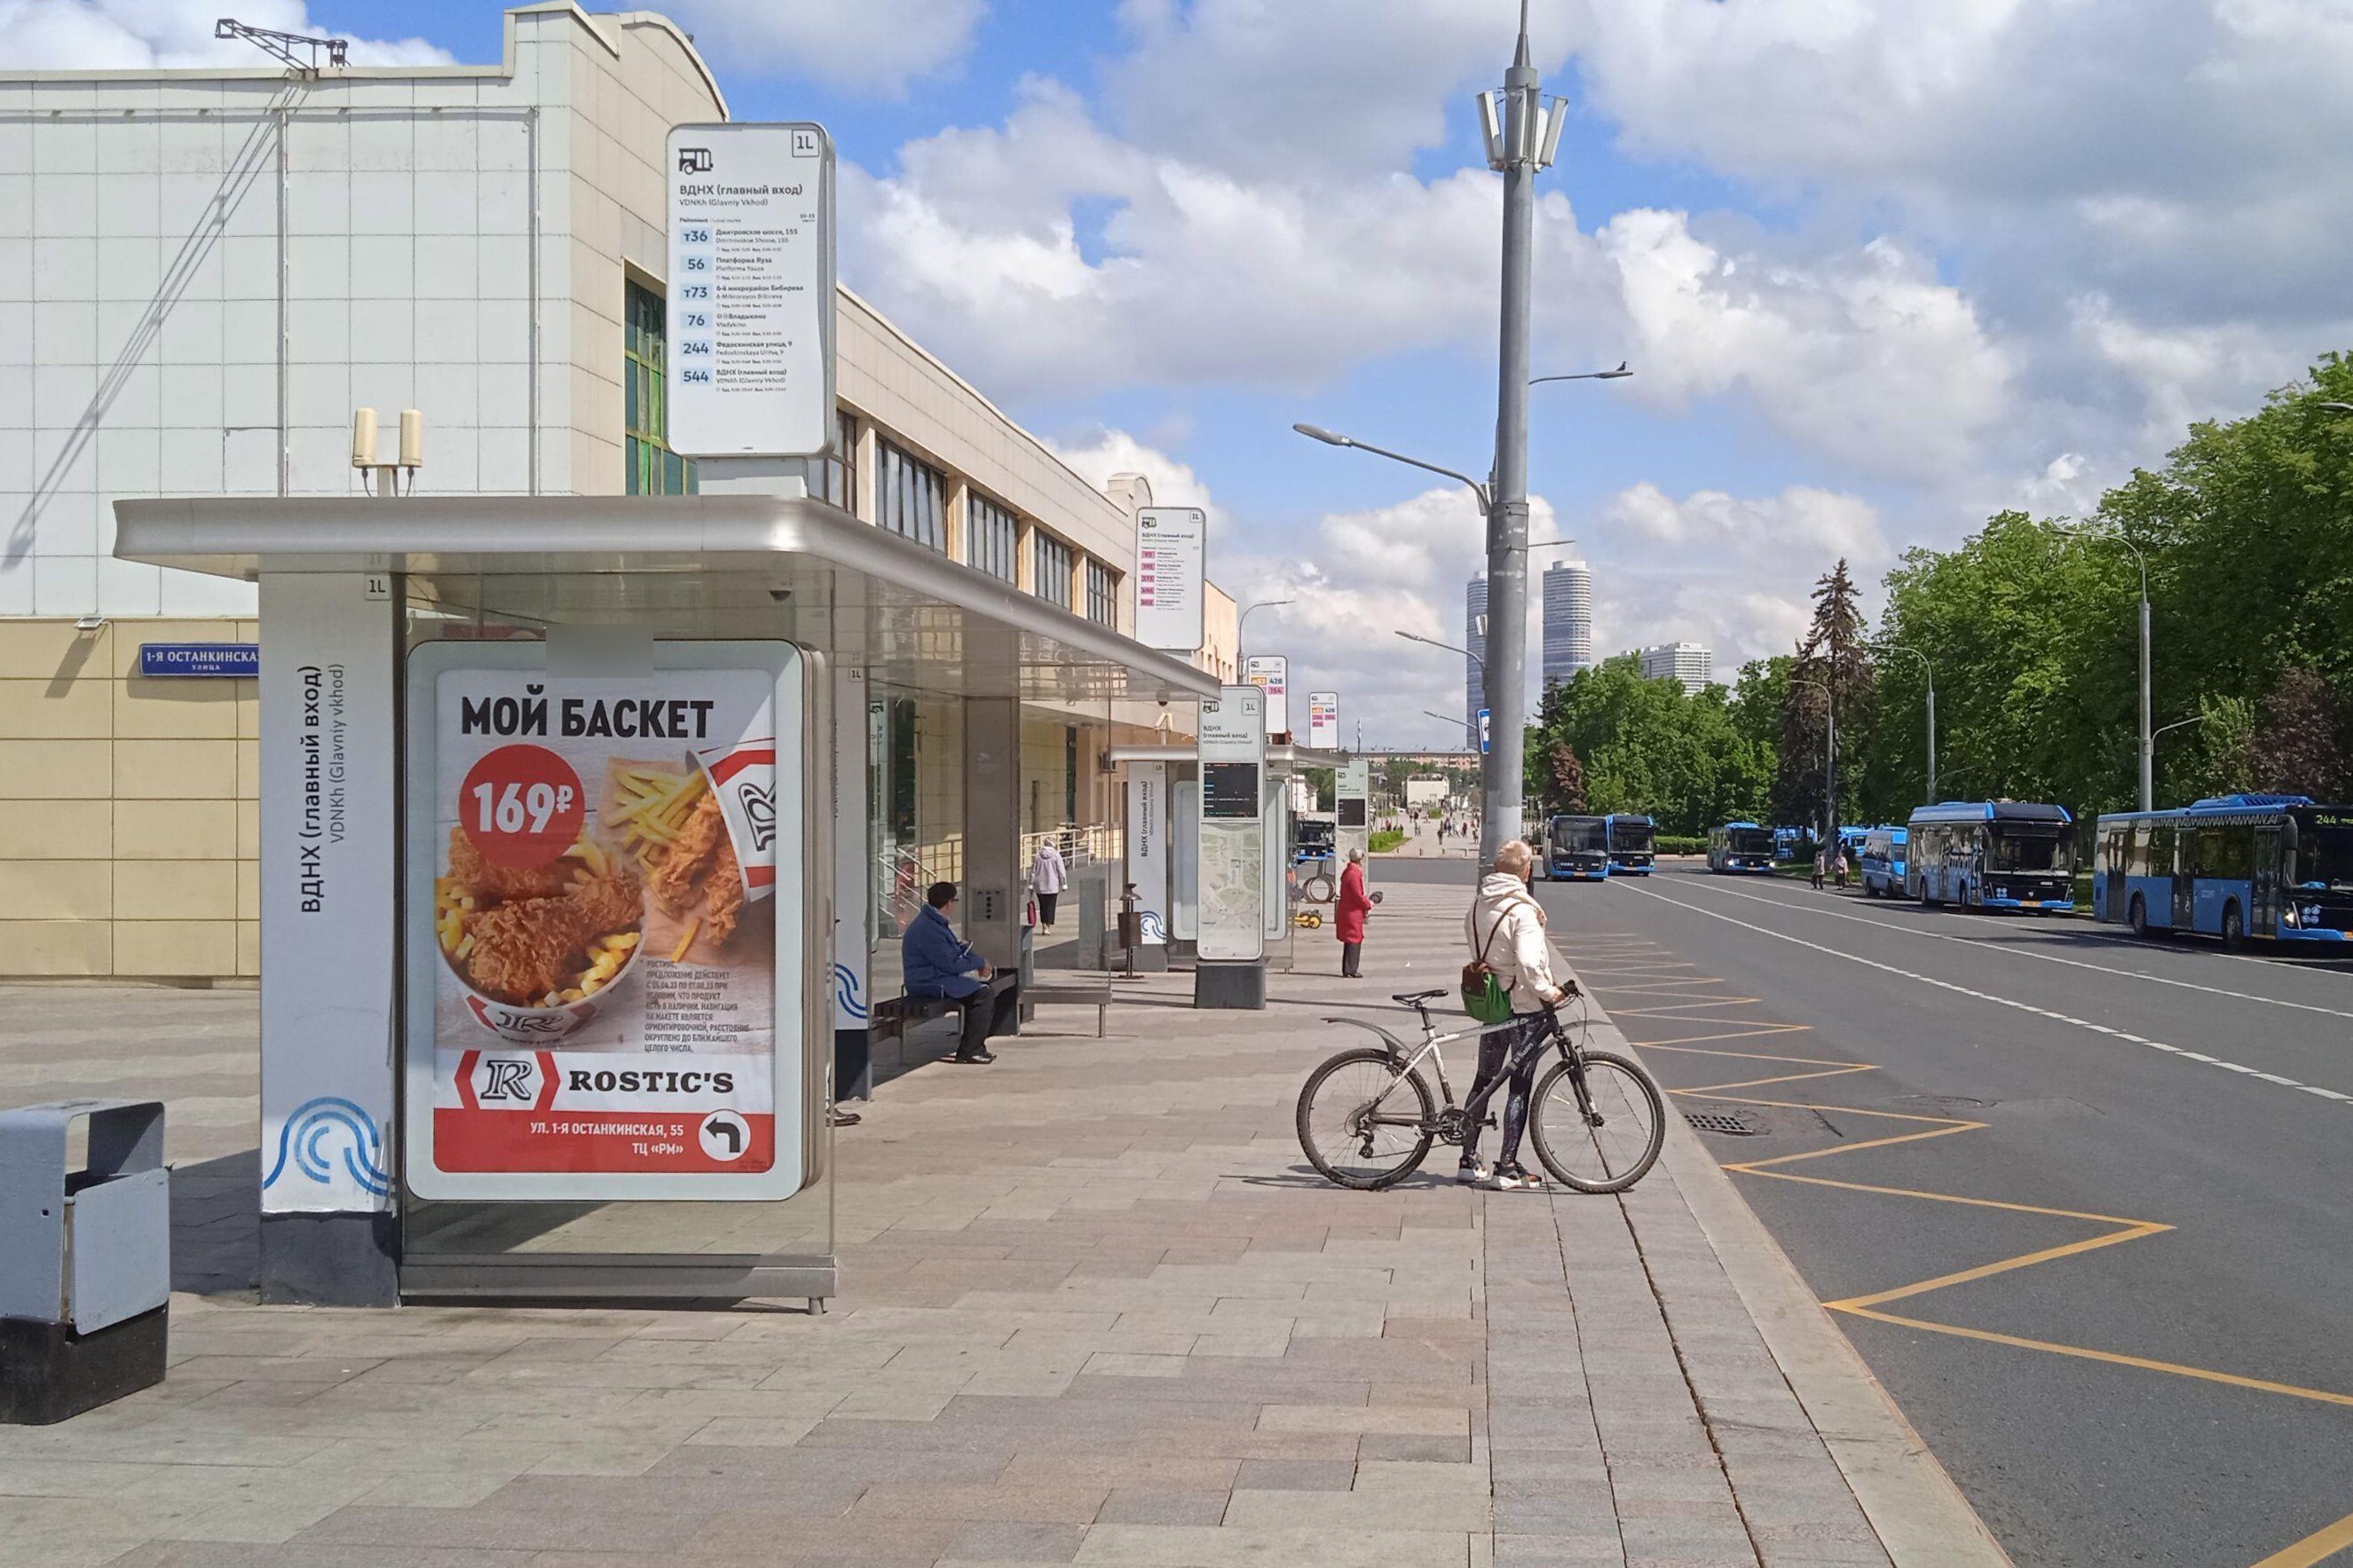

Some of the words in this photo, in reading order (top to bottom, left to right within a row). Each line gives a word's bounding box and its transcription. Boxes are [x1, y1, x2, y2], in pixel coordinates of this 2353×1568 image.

[797, 135, 814, 150] 1L
[679, 185, 715, 196] ВДНХ
[717, 184, 770, 196] (главный
[771, 184, 803, 196] вход)
[683, 230, 708, 242] т36
[687, 258, 706, 270] 56
[683, 287, 708, 298] т73
[687, 314, 706, 327] 76
[683, 343, 709, 354] 244
[683, 371, 709, 382] 544
[368, 579, 386, 594] 1L
[146, 651, 163, 662] 1-Я
[167, 651, 259, 663] ОСТАНКИНСКА
[297, 666, 322, 727] вход)
[328, 664, 345, 716] vkhod)
[462, 684, 548, 737] МОЙ
[561, 698, 715, 738] БАСКЕТ
[328, 720, 347, 784] (Glavniy
[298, 735, 322, 839] (главный
[329, 787, 344, 844] VDNKh
[2316, 814, 2337, 824] 244
[301, 845, 325, 913] ВДНХ
[691, 992, 721, 1001] ПРОДУКТ
[682, 1034, 691, 1043] ДО
[569, 1070, 734, 1093] ROSTIC'S
[530, 1122, 549, 1134] УЛ.
[552, 1123, 569, 1134] 1-Я
[572, 1123, 668, 1139] ОСТАНКИНСКАЯ,
[669, 1124, 684, 1136] 55
[632, 1142, 648, 1156] ТЦ
[651, 1143, 683, 1155] «РМ»
